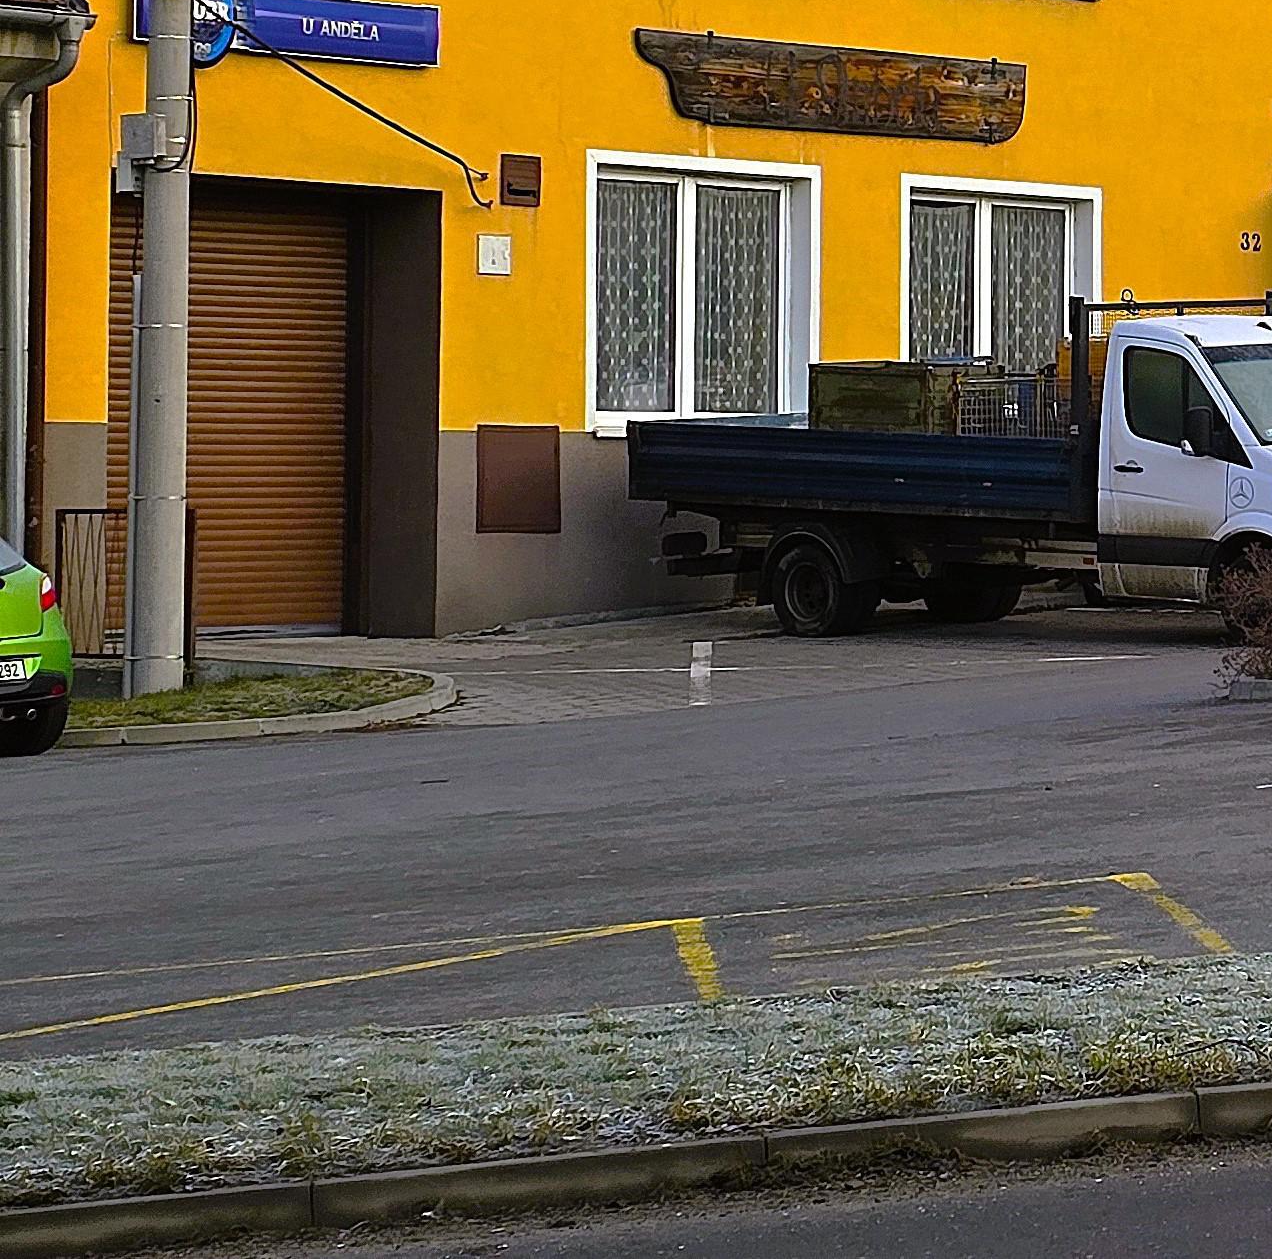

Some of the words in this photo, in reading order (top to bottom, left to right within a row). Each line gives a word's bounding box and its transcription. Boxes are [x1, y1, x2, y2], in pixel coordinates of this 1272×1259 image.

[302, 17, 315, 35] U
[320, 20, 379, 41] ANDĚLA
[1240, 232, 1261, 252] 32
